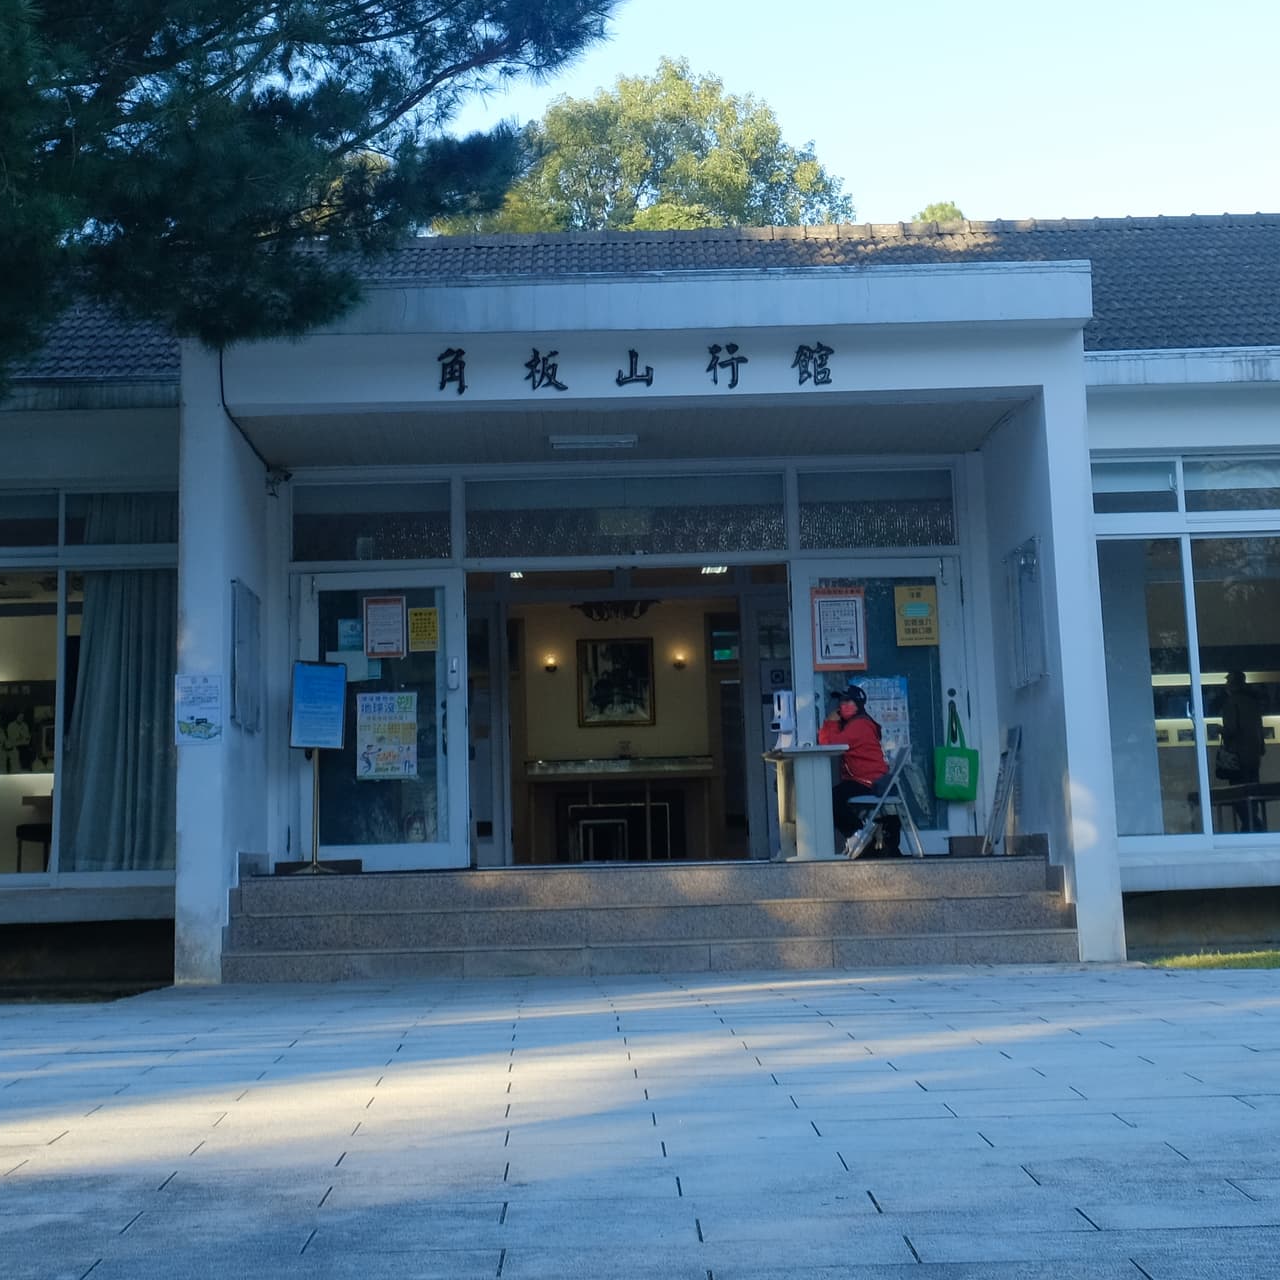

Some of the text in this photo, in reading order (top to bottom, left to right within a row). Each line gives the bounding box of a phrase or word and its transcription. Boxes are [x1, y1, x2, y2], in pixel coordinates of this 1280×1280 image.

[437, 341, 834, 395] 角板山行館
